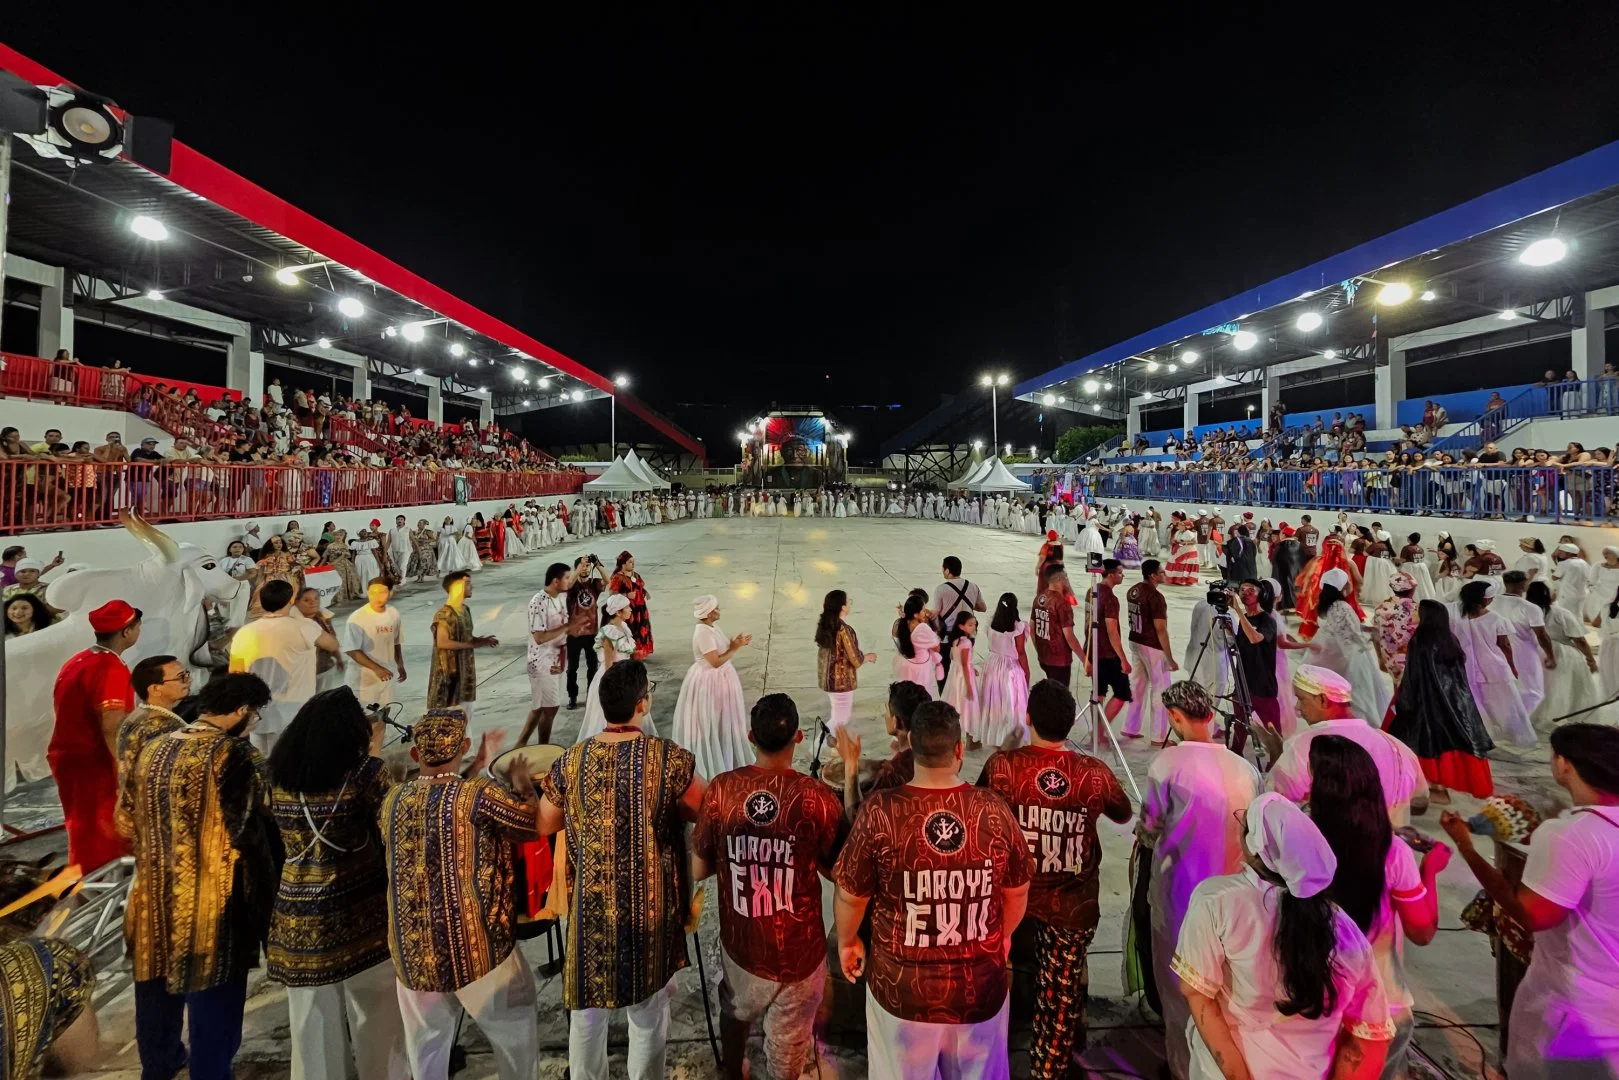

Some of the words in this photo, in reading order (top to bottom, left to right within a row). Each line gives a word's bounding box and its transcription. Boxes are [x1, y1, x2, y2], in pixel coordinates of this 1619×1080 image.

[1018, 804, 1088, 834] LAROYÊ
[726, 834, 796, 866] LAROYÊ
[729, 861, 795, 918] EXU
[903, 859, 993, 902] LAROYÊ
[903, 898, 991, 948] EXU
